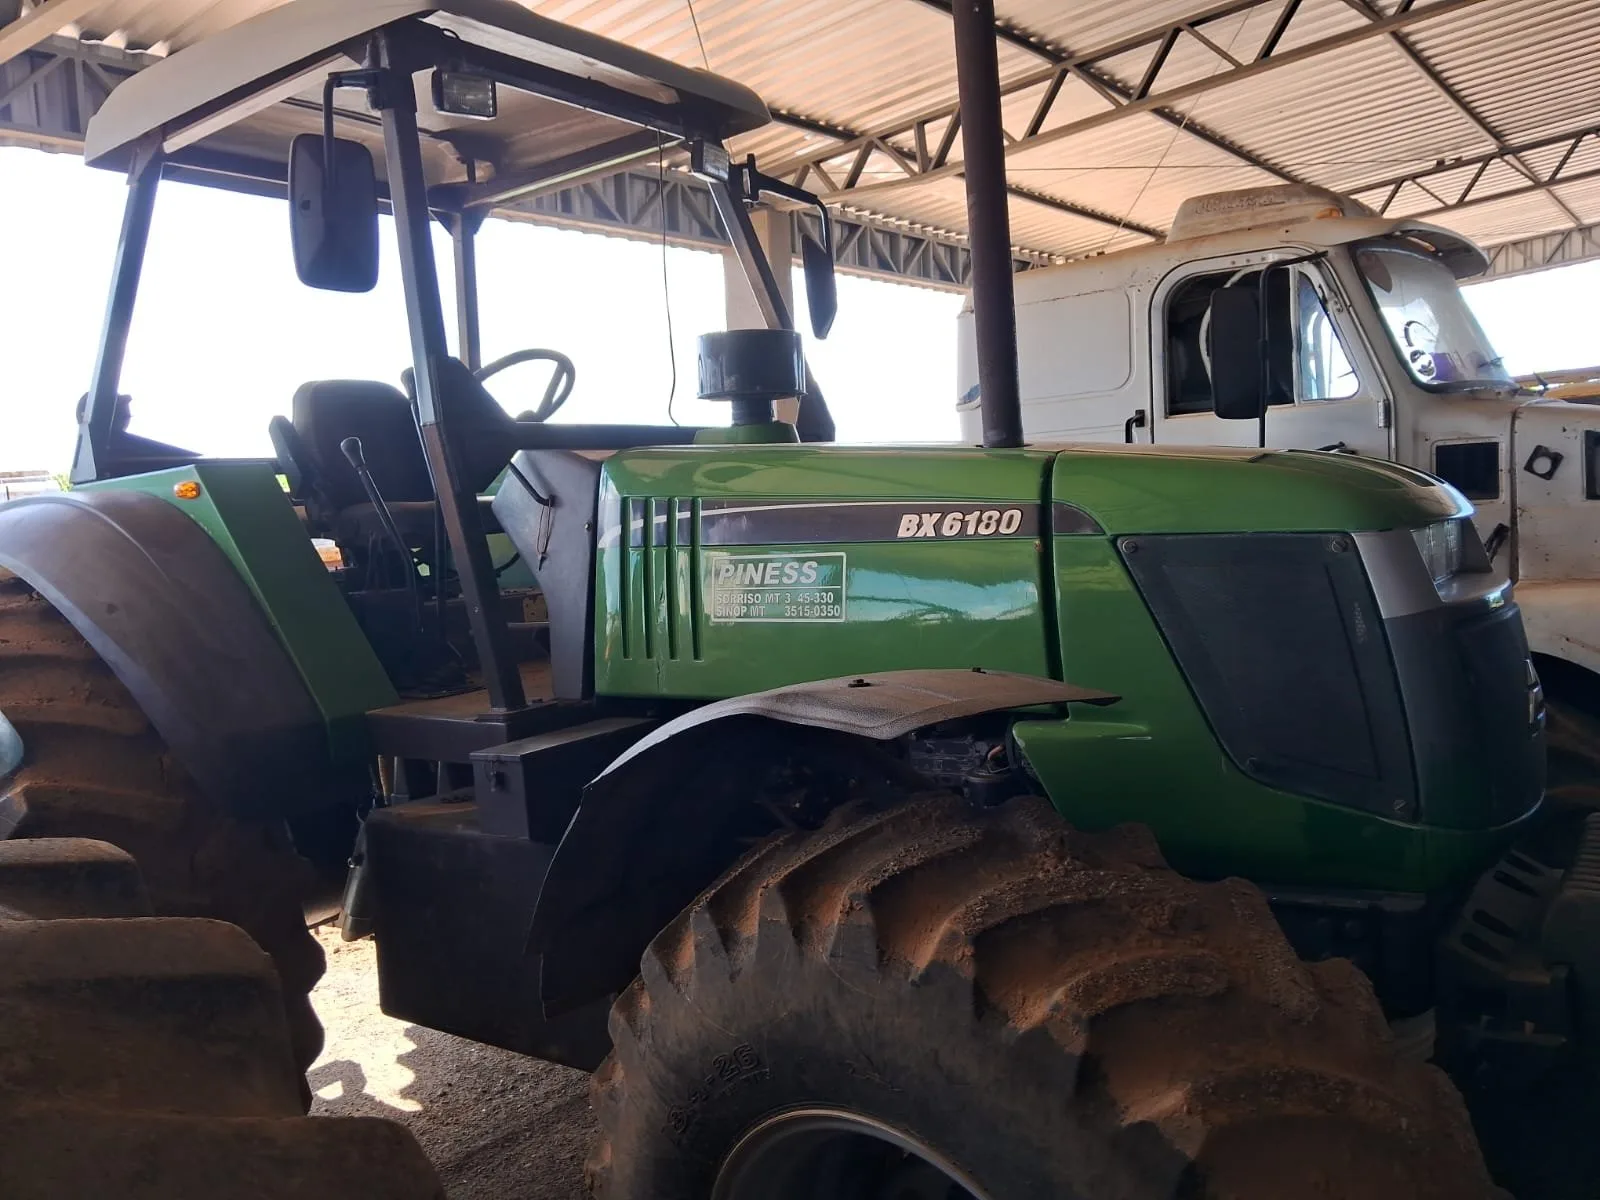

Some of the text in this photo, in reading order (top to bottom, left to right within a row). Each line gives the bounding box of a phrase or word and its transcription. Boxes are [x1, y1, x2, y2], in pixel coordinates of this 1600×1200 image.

[718, 560, 818, 586] PINESS
[715, 593, 761, 605] SORRISO
[765, 593, 781, 604] MT
[715, 604, 841, 617] SINOP MT 3515-0350
